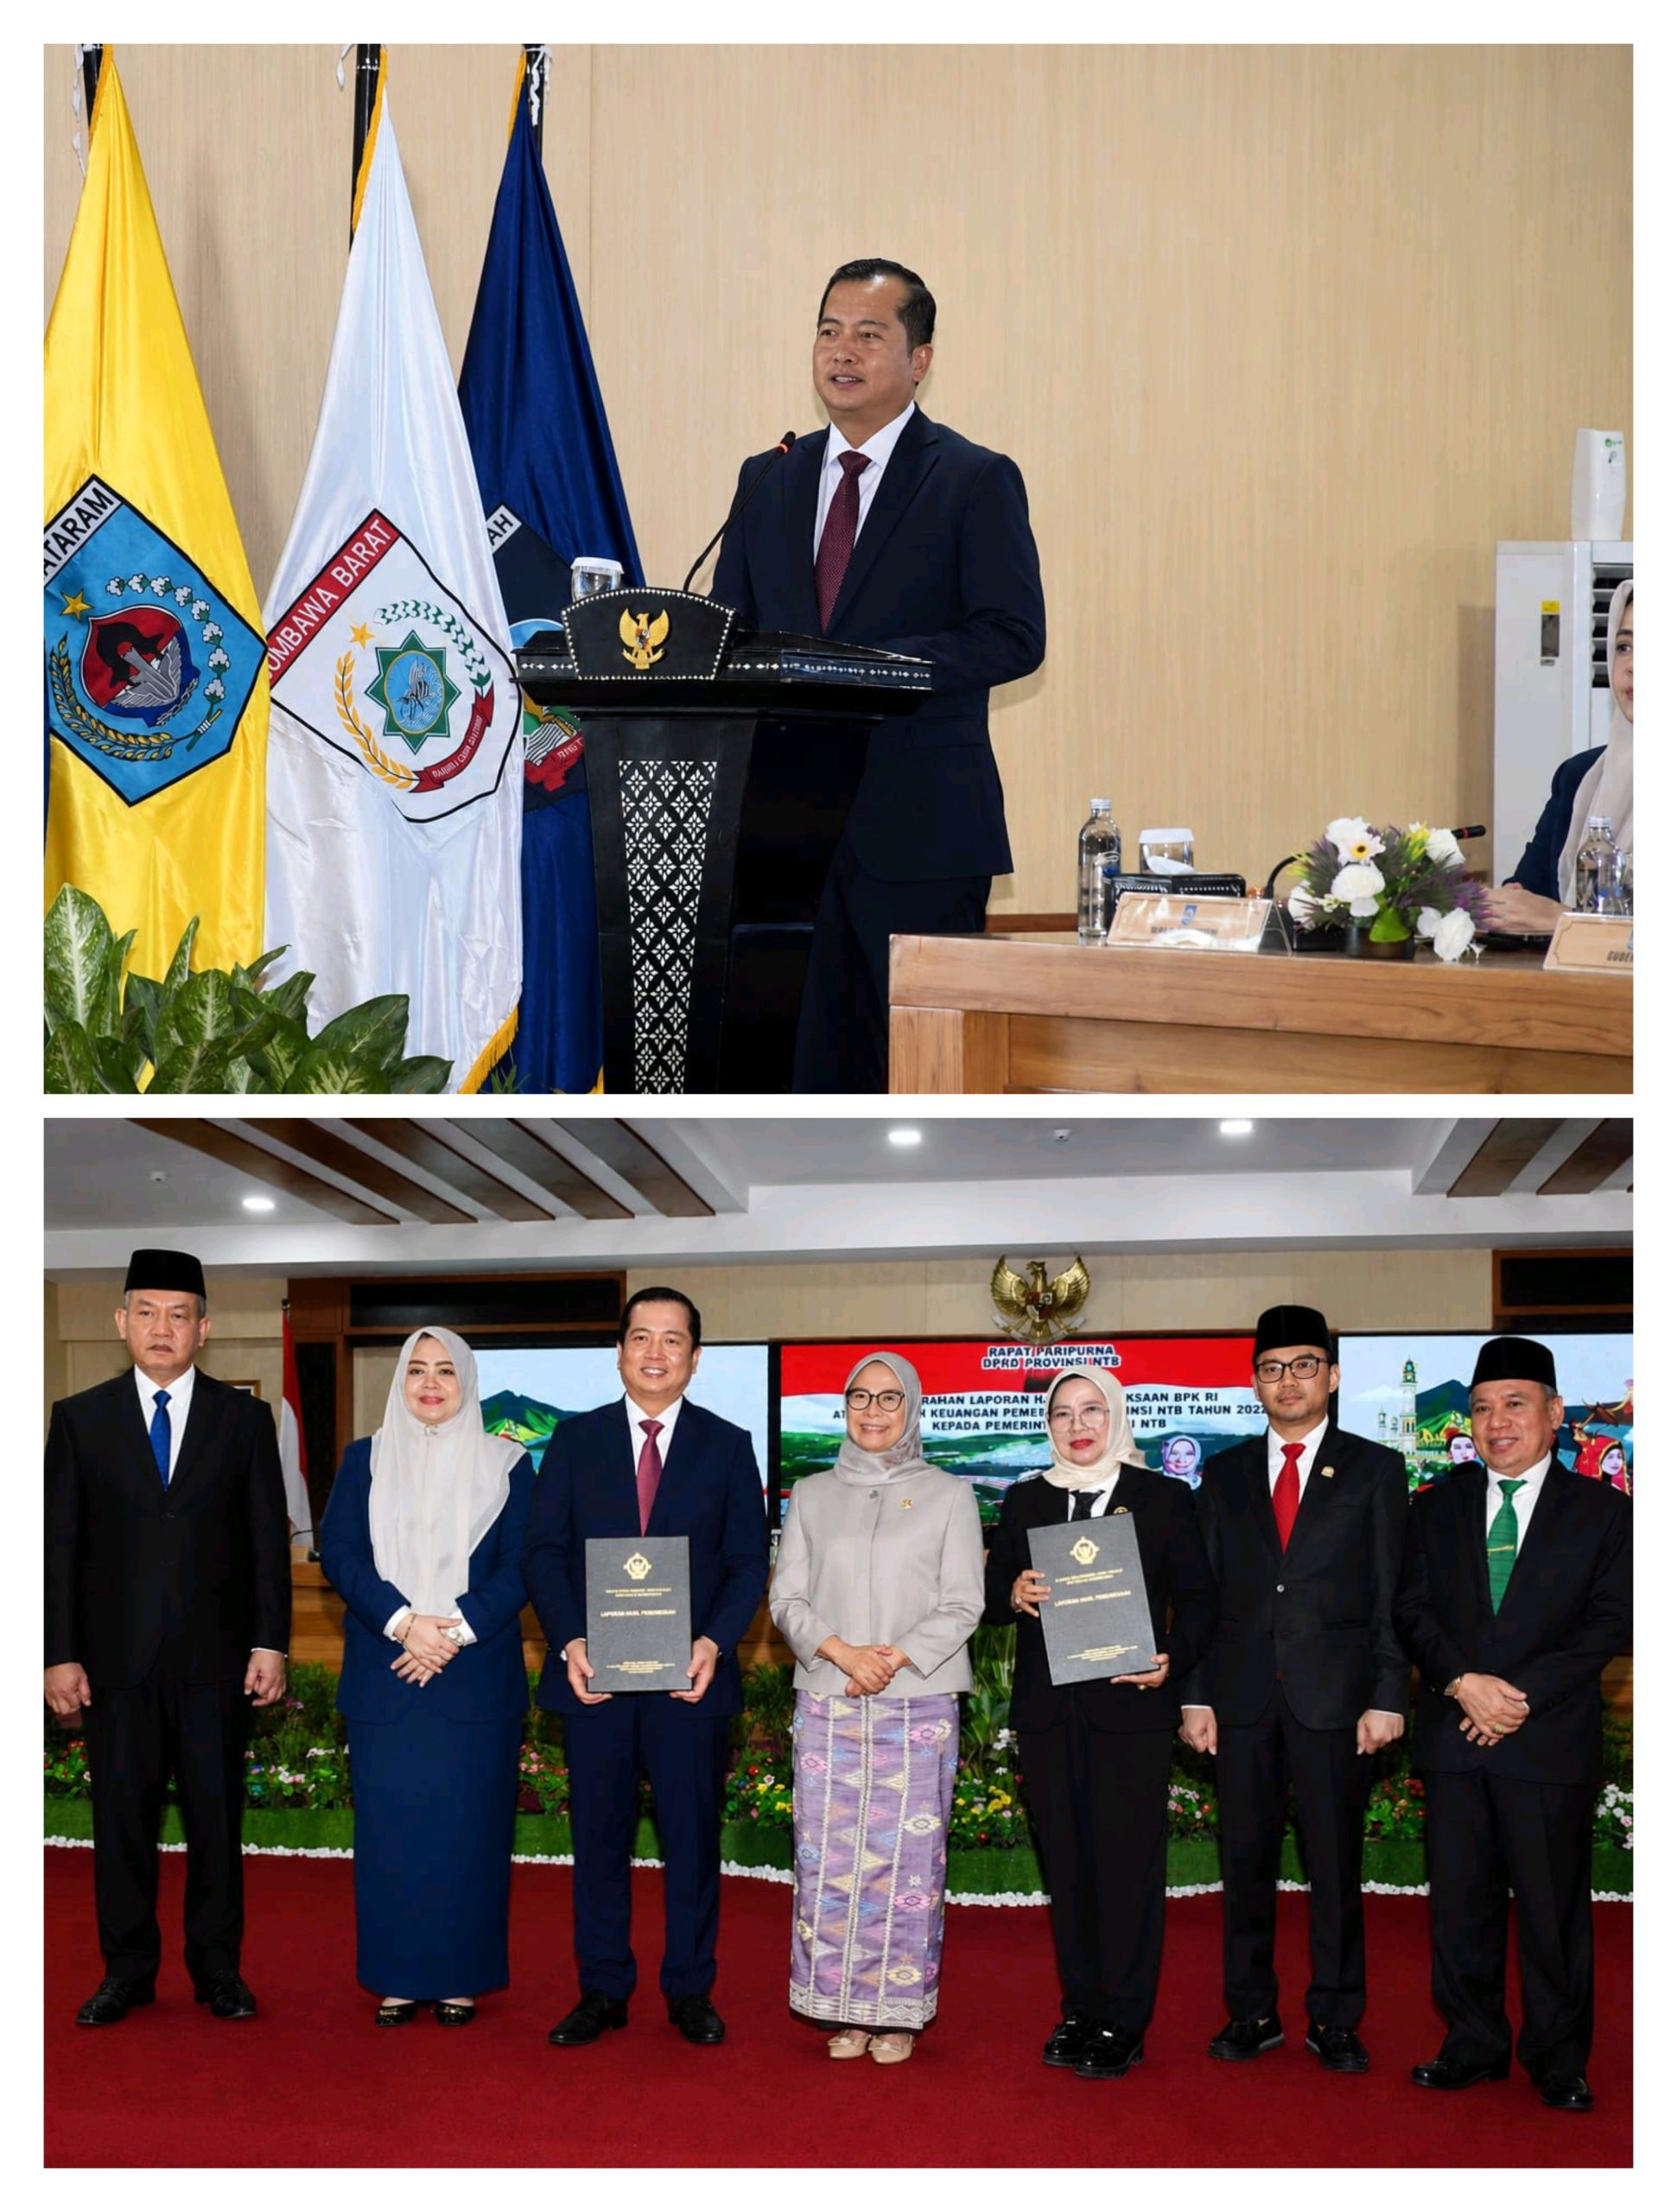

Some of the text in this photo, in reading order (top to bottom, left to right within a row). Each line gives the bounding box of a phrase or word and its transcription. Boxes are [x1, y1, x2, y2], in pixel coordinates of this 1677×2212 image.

[44, 486, 114, 577] ATARAM
[269, 519, 391, 677] UMBAWA BARAT
[988, 1345, 1114, 1357] RAPAT PARIPURNA
[982, 1357, 1120, 1369] DPRD PROVINSI NTB
[922, 1395, 965, 1405] RAHAN
[969, 1395, 1029, 1405] LAPORAN
[1126, 1392, 1218, 1402] KSAAN BPK RI
[931, 1408, 999, 1418] KEUANGAN
[1126, 1405, 1153, 1415] INSI
[1158, 1405, 1183, 1415] NTB
[1188, 1405, 1231, 1414] TAHUN
[932, 1421, 1046, 1431] KEPADA PEMERINT
[1140, 1418, 1166, 1428] NTB
